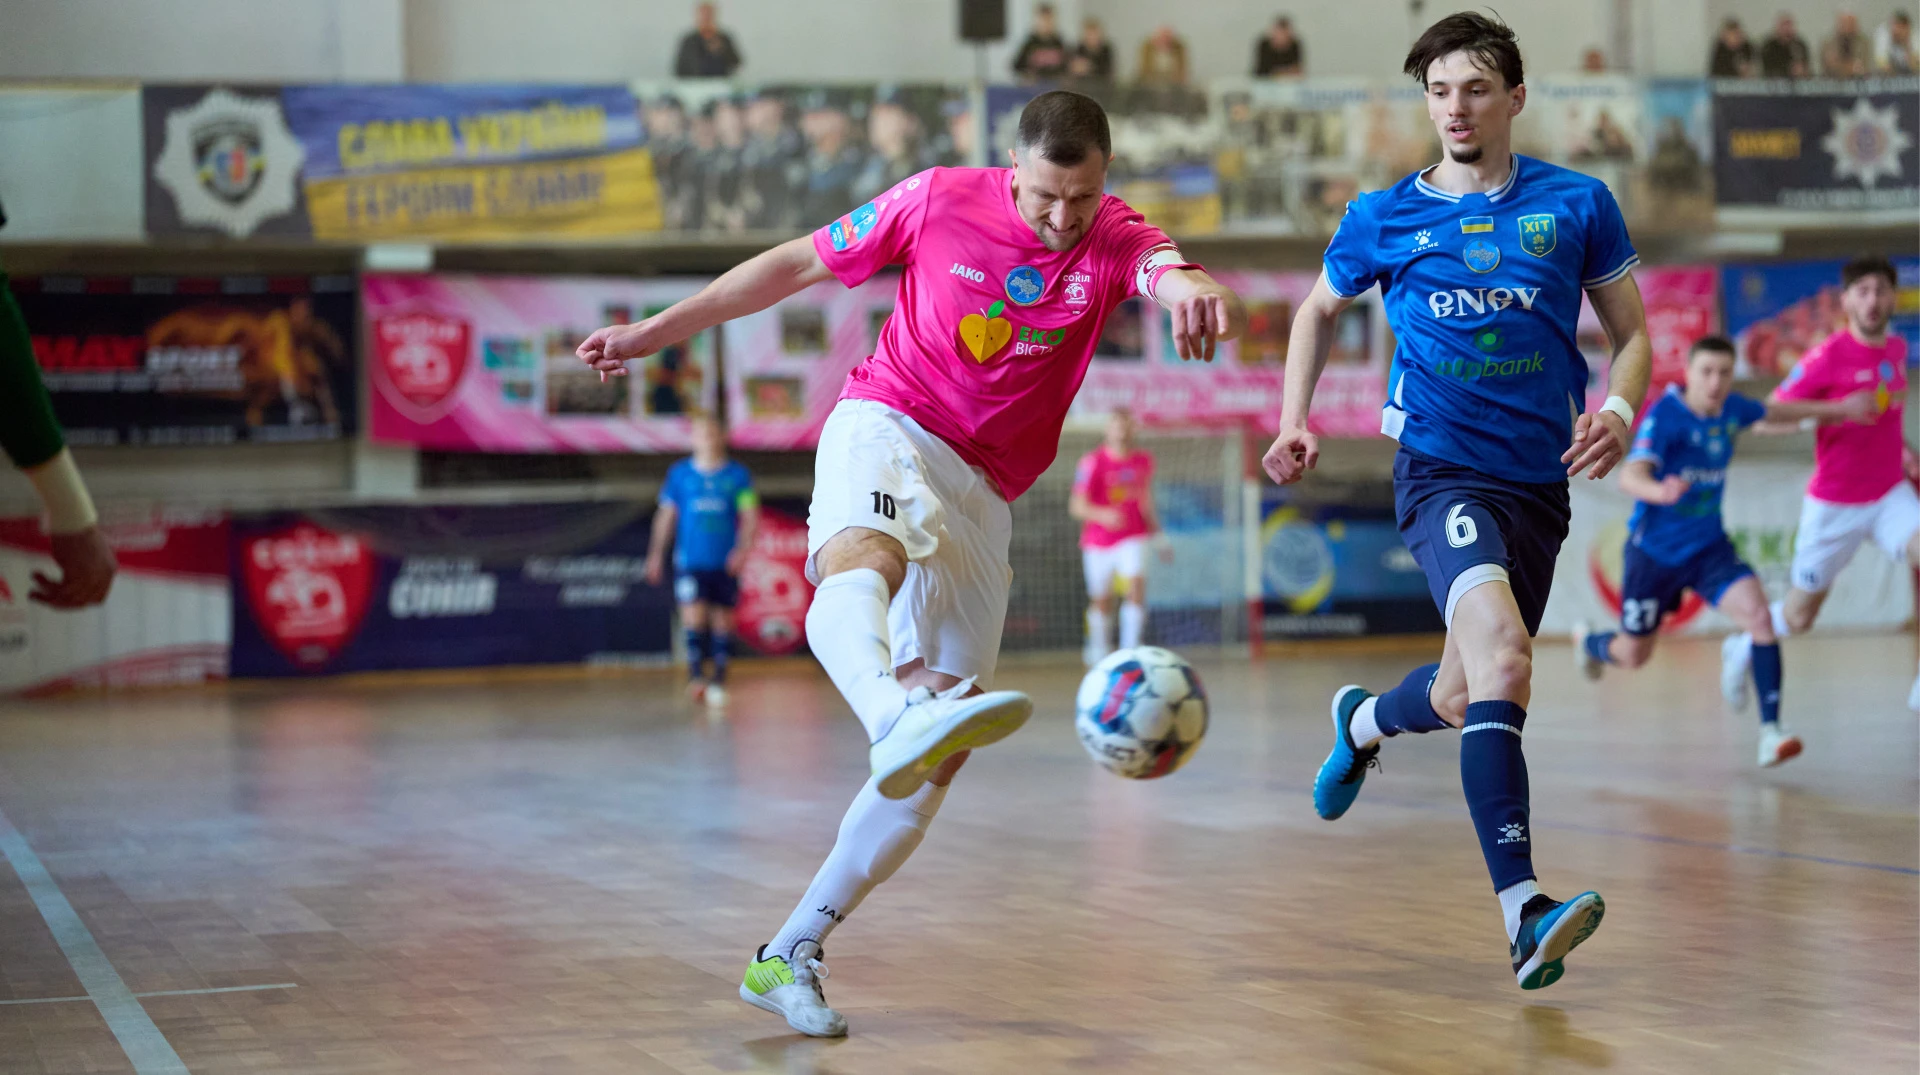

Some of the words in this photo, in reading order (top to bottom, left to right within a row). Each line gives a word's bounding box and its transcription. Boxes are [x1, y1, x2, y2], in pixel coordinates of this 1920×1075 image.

[1411, 241, 1440, 254] KELME
[949, 263, 985, 283] JAKO
[1063, 274, 1091, 283] СОКІЛ
[870, 490, 897, 520] 10
[1445, 503, 1478, 549] 6
[1623, 597, 1660, 631] 27
